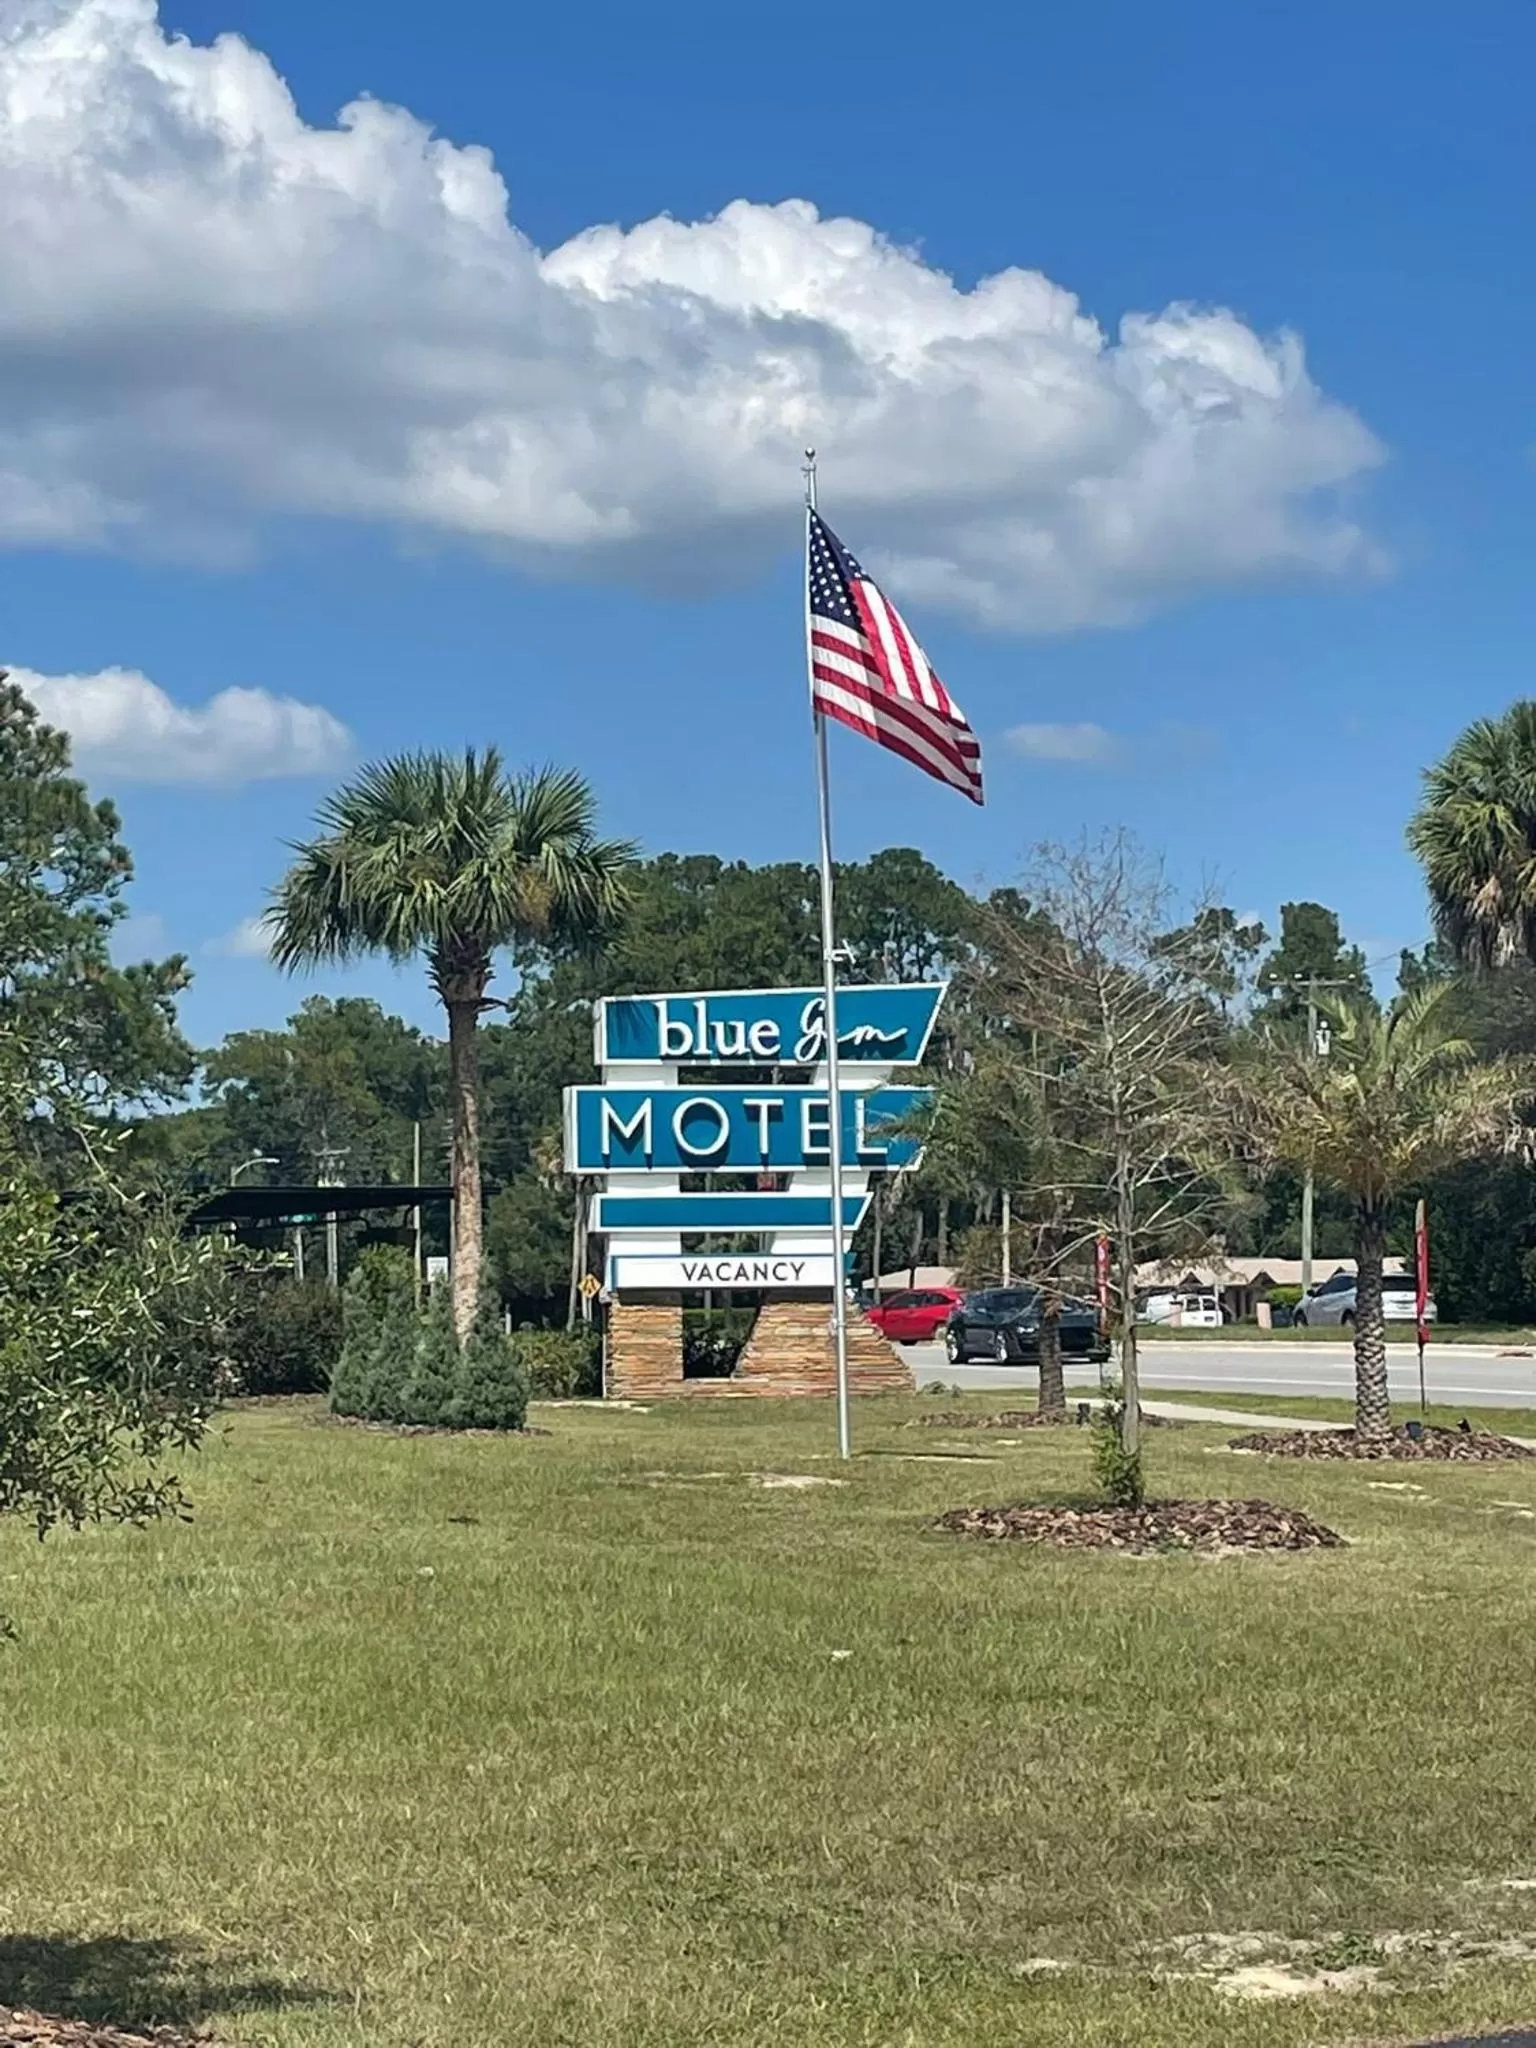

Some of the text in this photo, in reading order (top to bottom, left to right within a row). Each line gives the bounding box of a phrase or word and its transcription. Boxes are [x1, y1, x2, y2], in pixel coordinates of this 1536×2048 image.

[657, 997, 908, 1062] blue Gm
[602, 1097, 887, 1155] MOTEL
[681, 1261, 806, 1283] VACANCY
